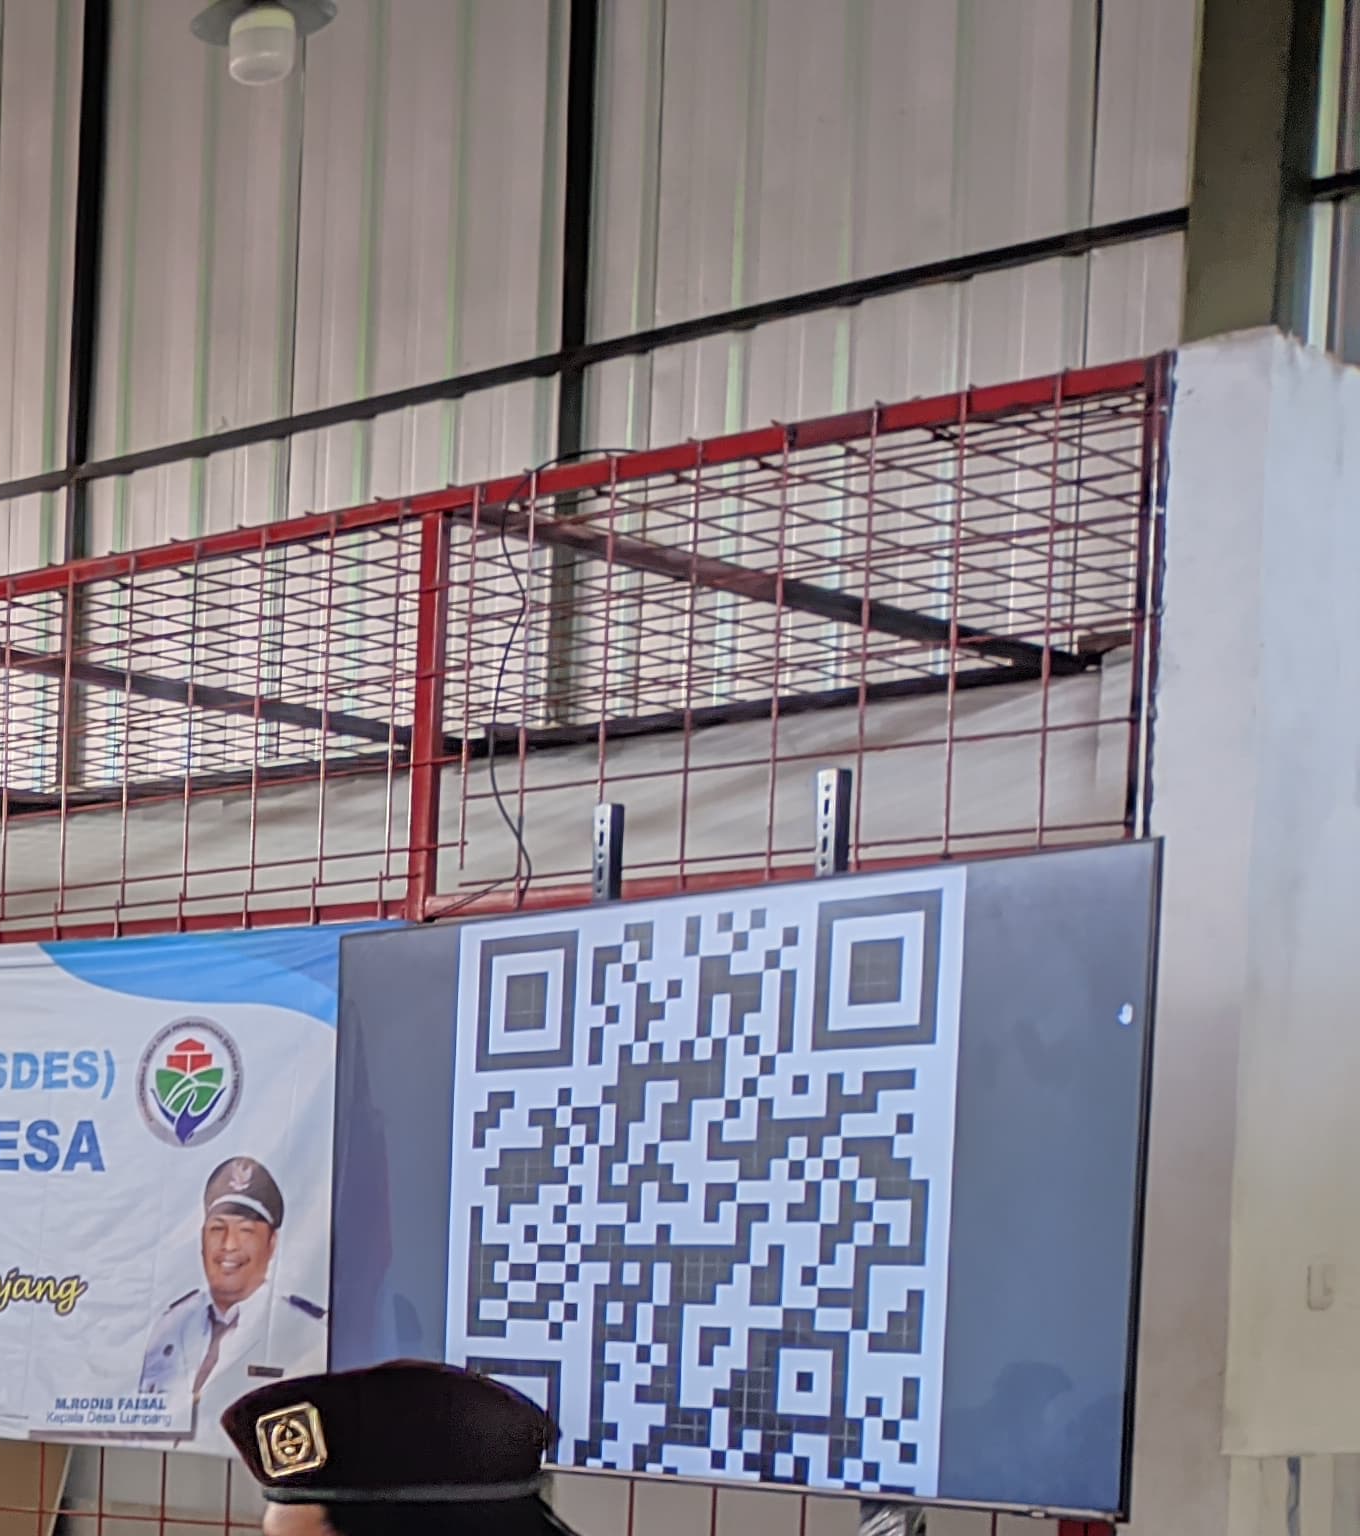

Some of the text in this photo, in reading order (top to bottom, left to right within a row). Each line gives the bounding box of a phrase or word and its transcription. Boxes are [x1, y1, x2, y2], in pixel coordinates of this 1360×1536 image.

[117, 1398, 167, 1410] FAISAL
[47, 1411, 172, 1427] Kepala Desa Lumpang
